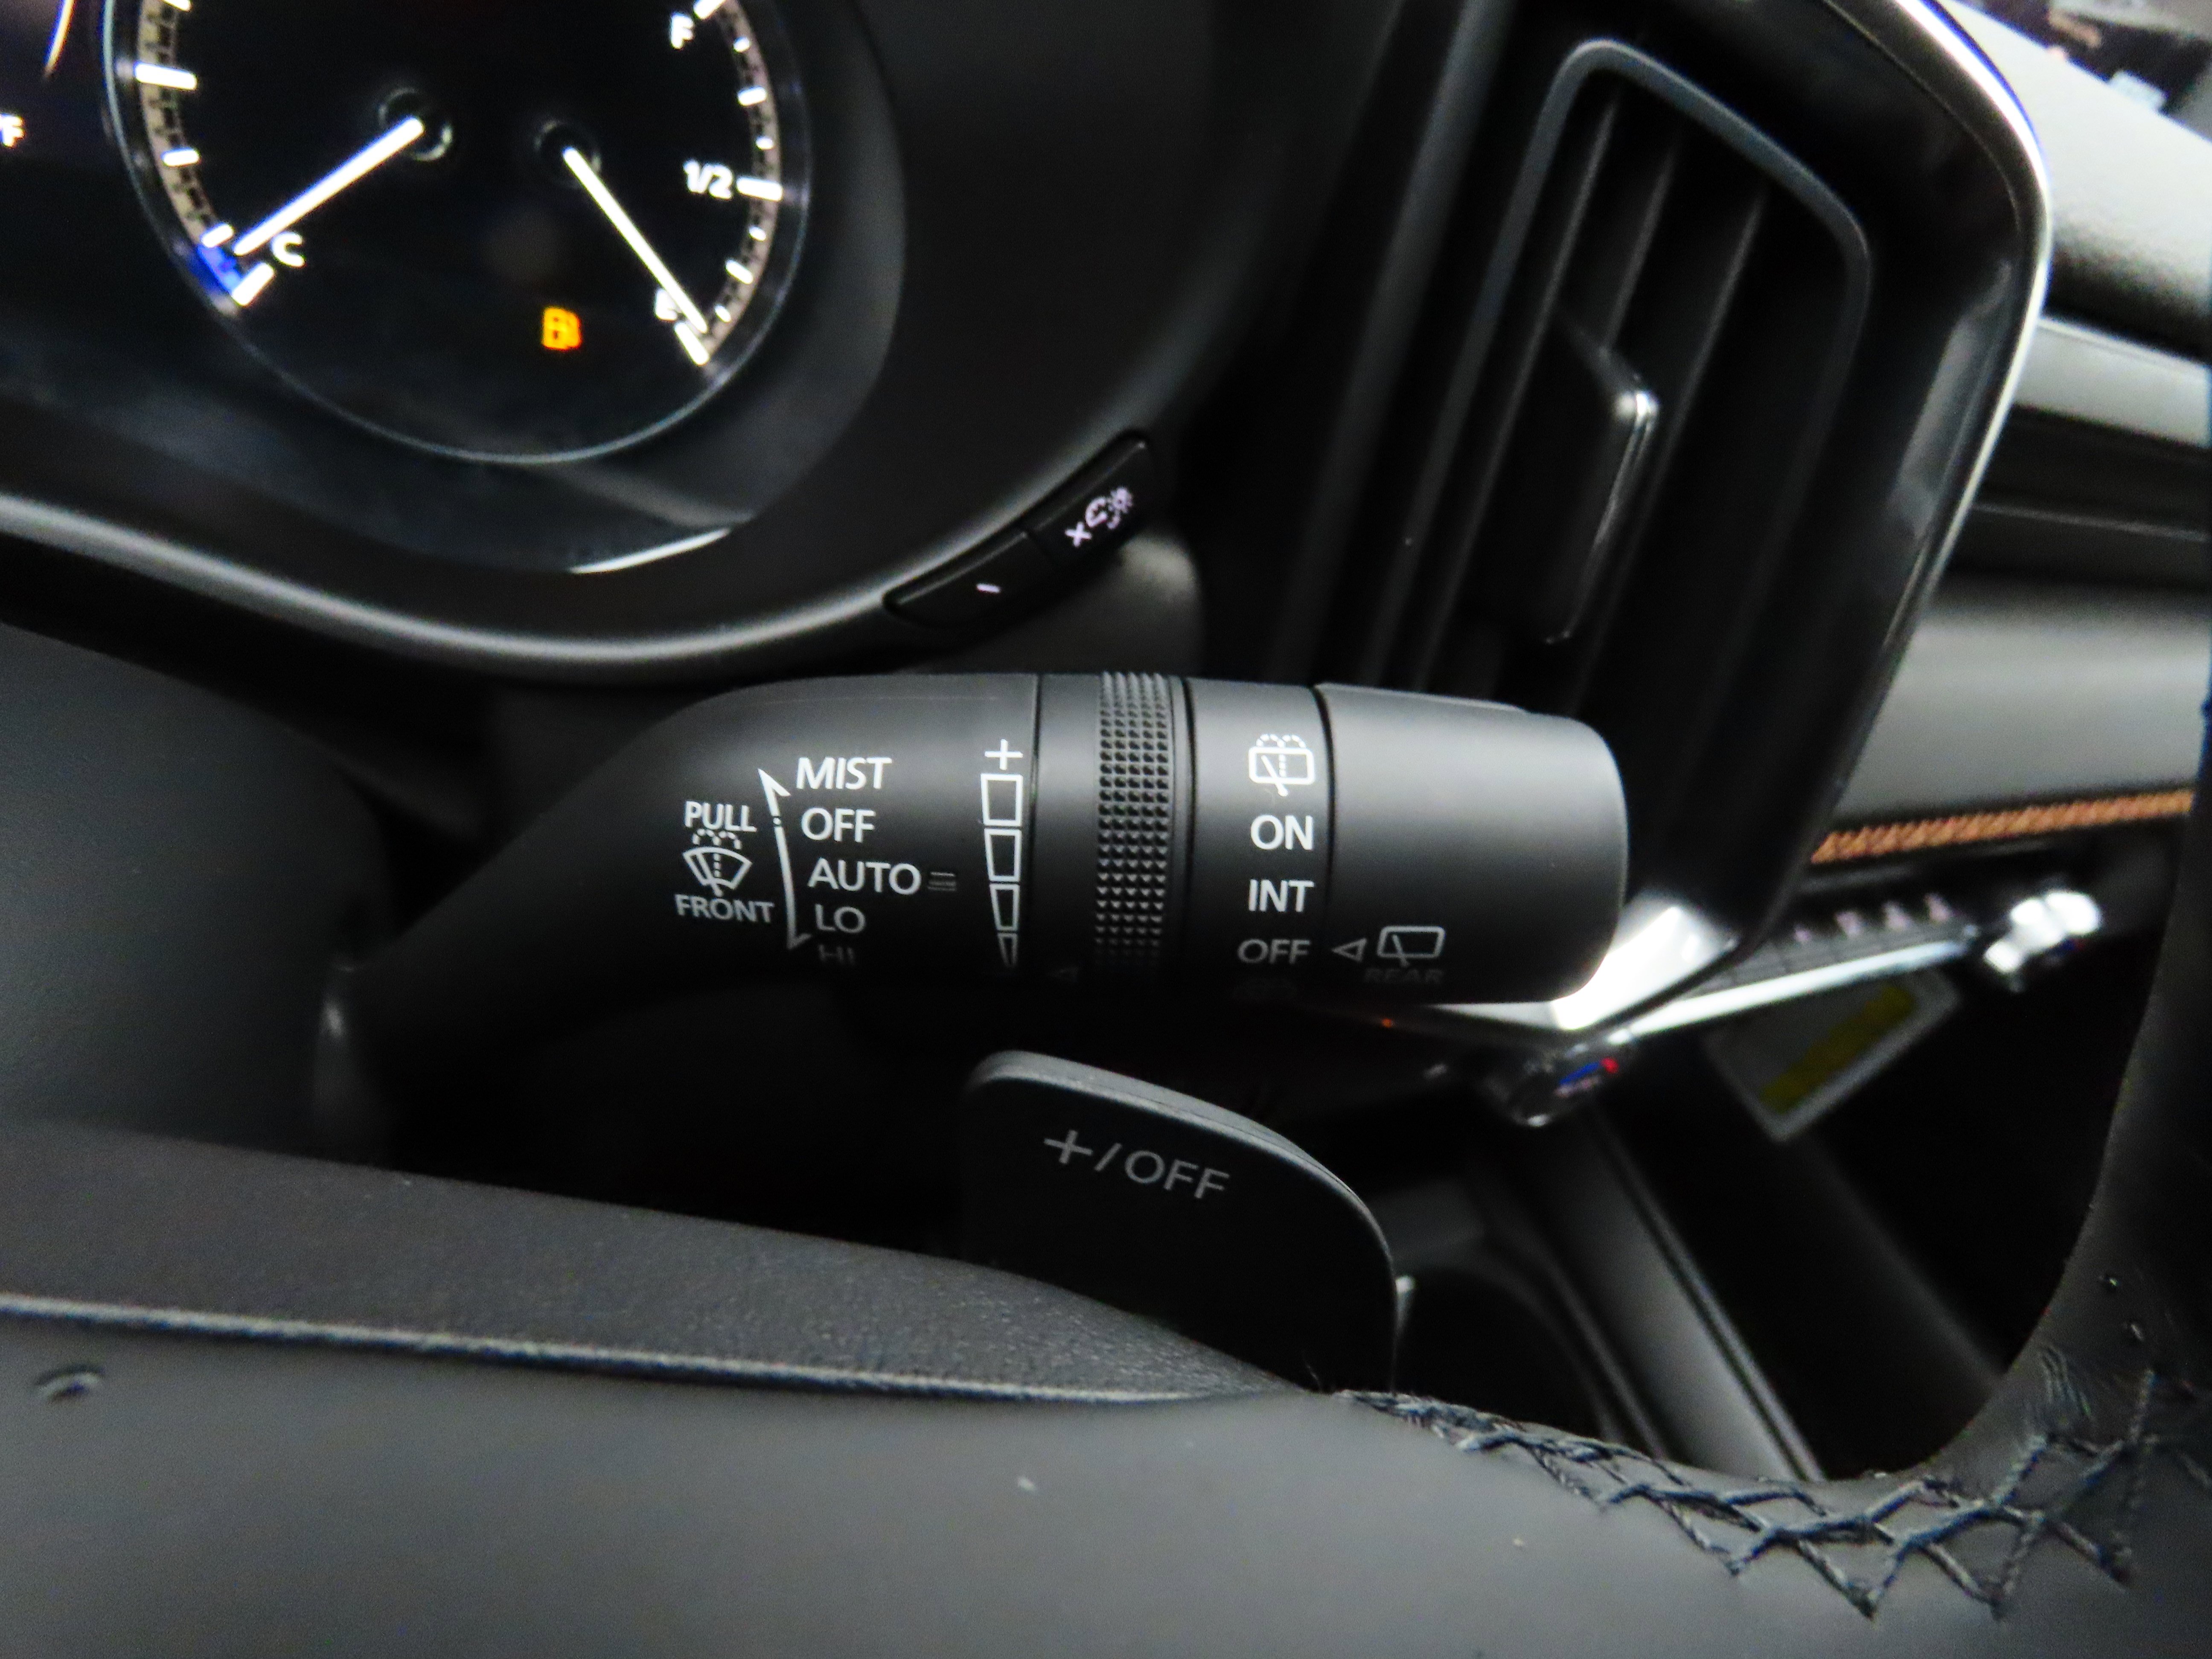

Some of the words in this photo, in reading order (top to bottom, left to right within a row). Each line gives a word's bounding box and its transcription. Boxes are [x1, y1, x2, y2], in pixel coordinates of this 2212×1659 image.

[684, 159, 733, 200] 1/2
[272, 232, 305, 268] C
[797, 757, 892, 790] MIST
[685, 800, 757, 832] PULL
[801, 808, 876, 843] OFF
[1251, 815, 1313, 850] ON
[808, 858, 921, 895] AUTO
[675, 893, 774, 923] FRONT
[1249, 879, 1314, 912] INT
[815, 904, 865, 933] LO
[1237, 938, 1311, 964] OFF
